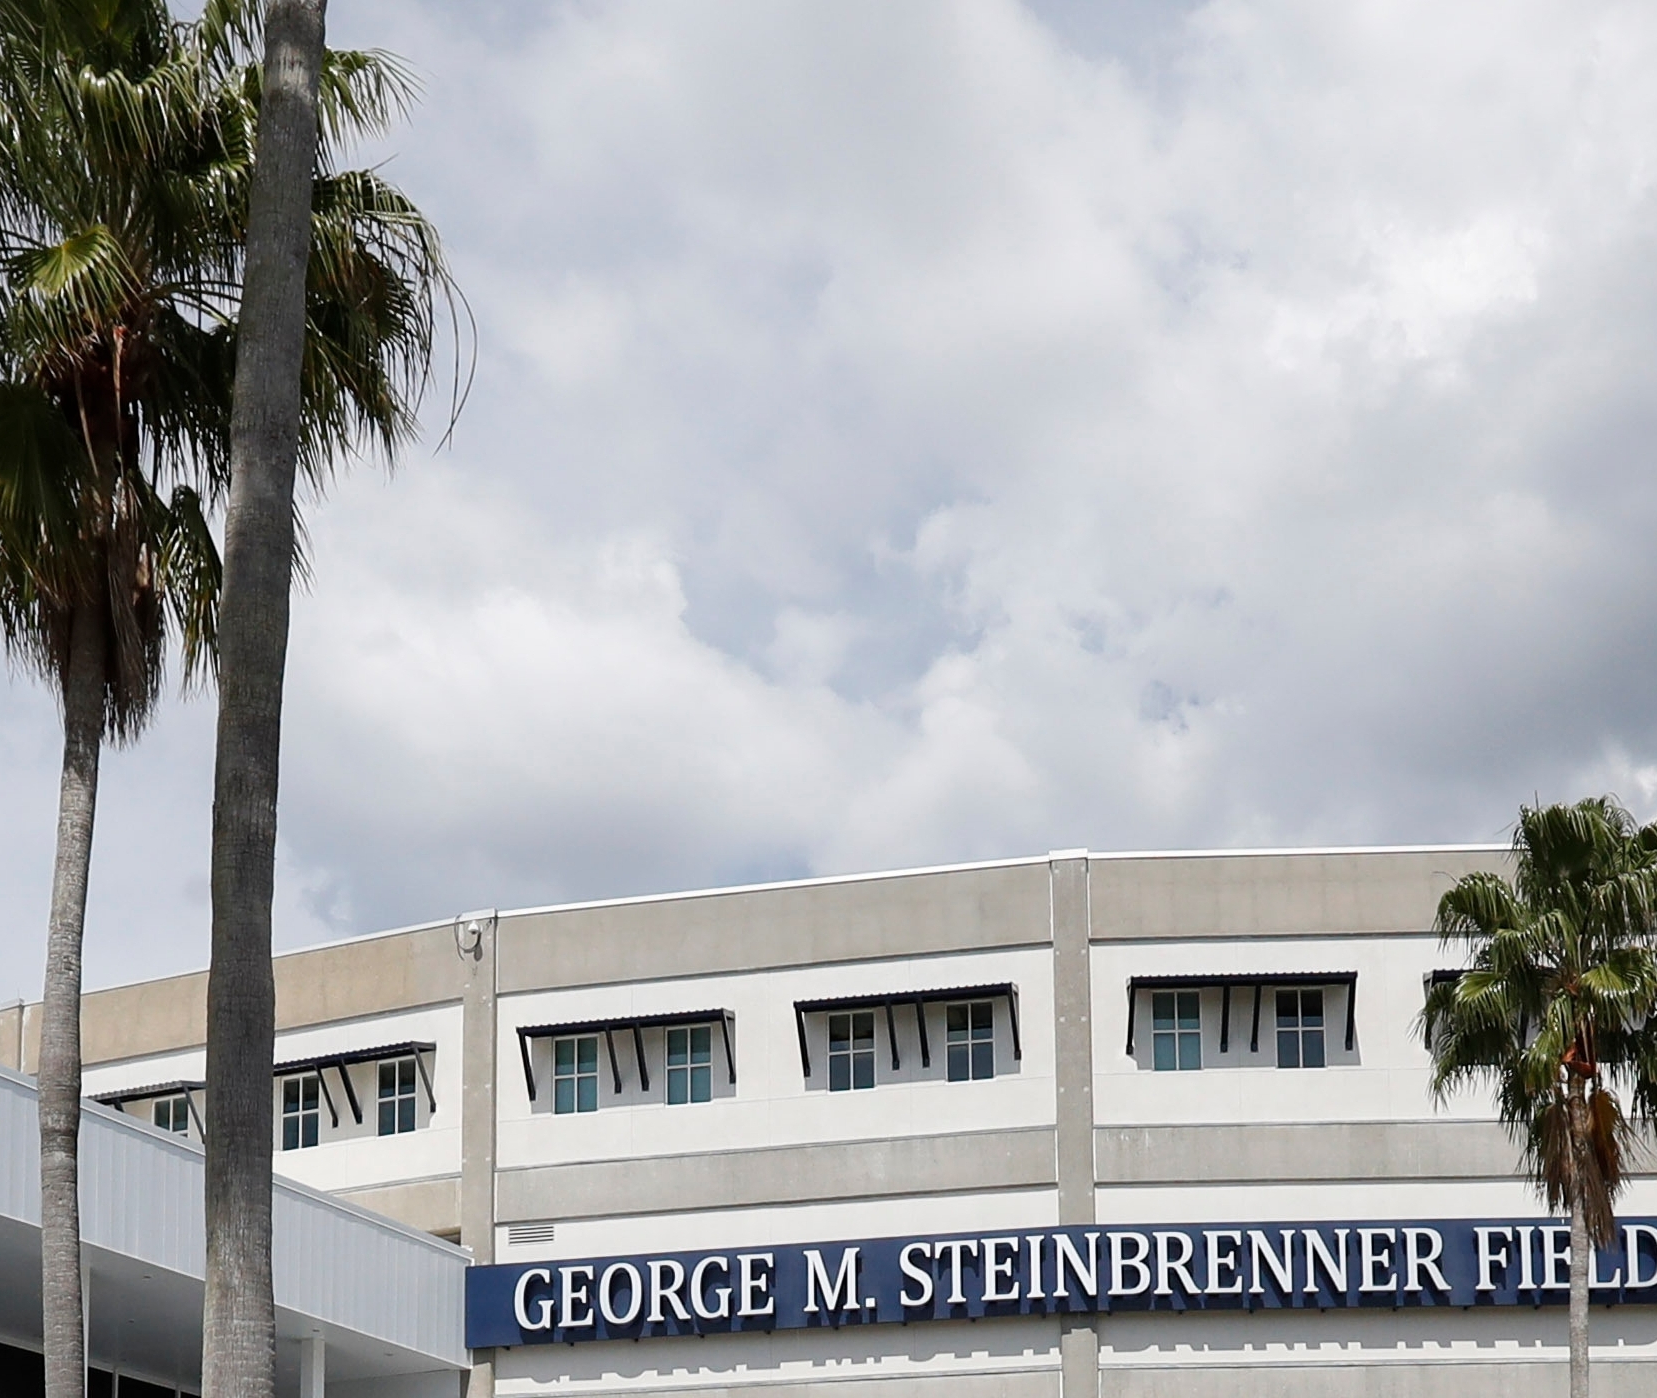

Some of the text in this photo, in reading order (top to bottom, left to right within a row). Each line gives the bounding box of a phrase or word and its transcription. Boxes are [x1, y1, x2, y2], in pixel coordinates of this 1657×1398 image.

[514, 1252, 775, 1331] GEORGE
[802, 1247, 877, 1312] M.
[899, 1225, 1452, 1307] STEINBRENNER
